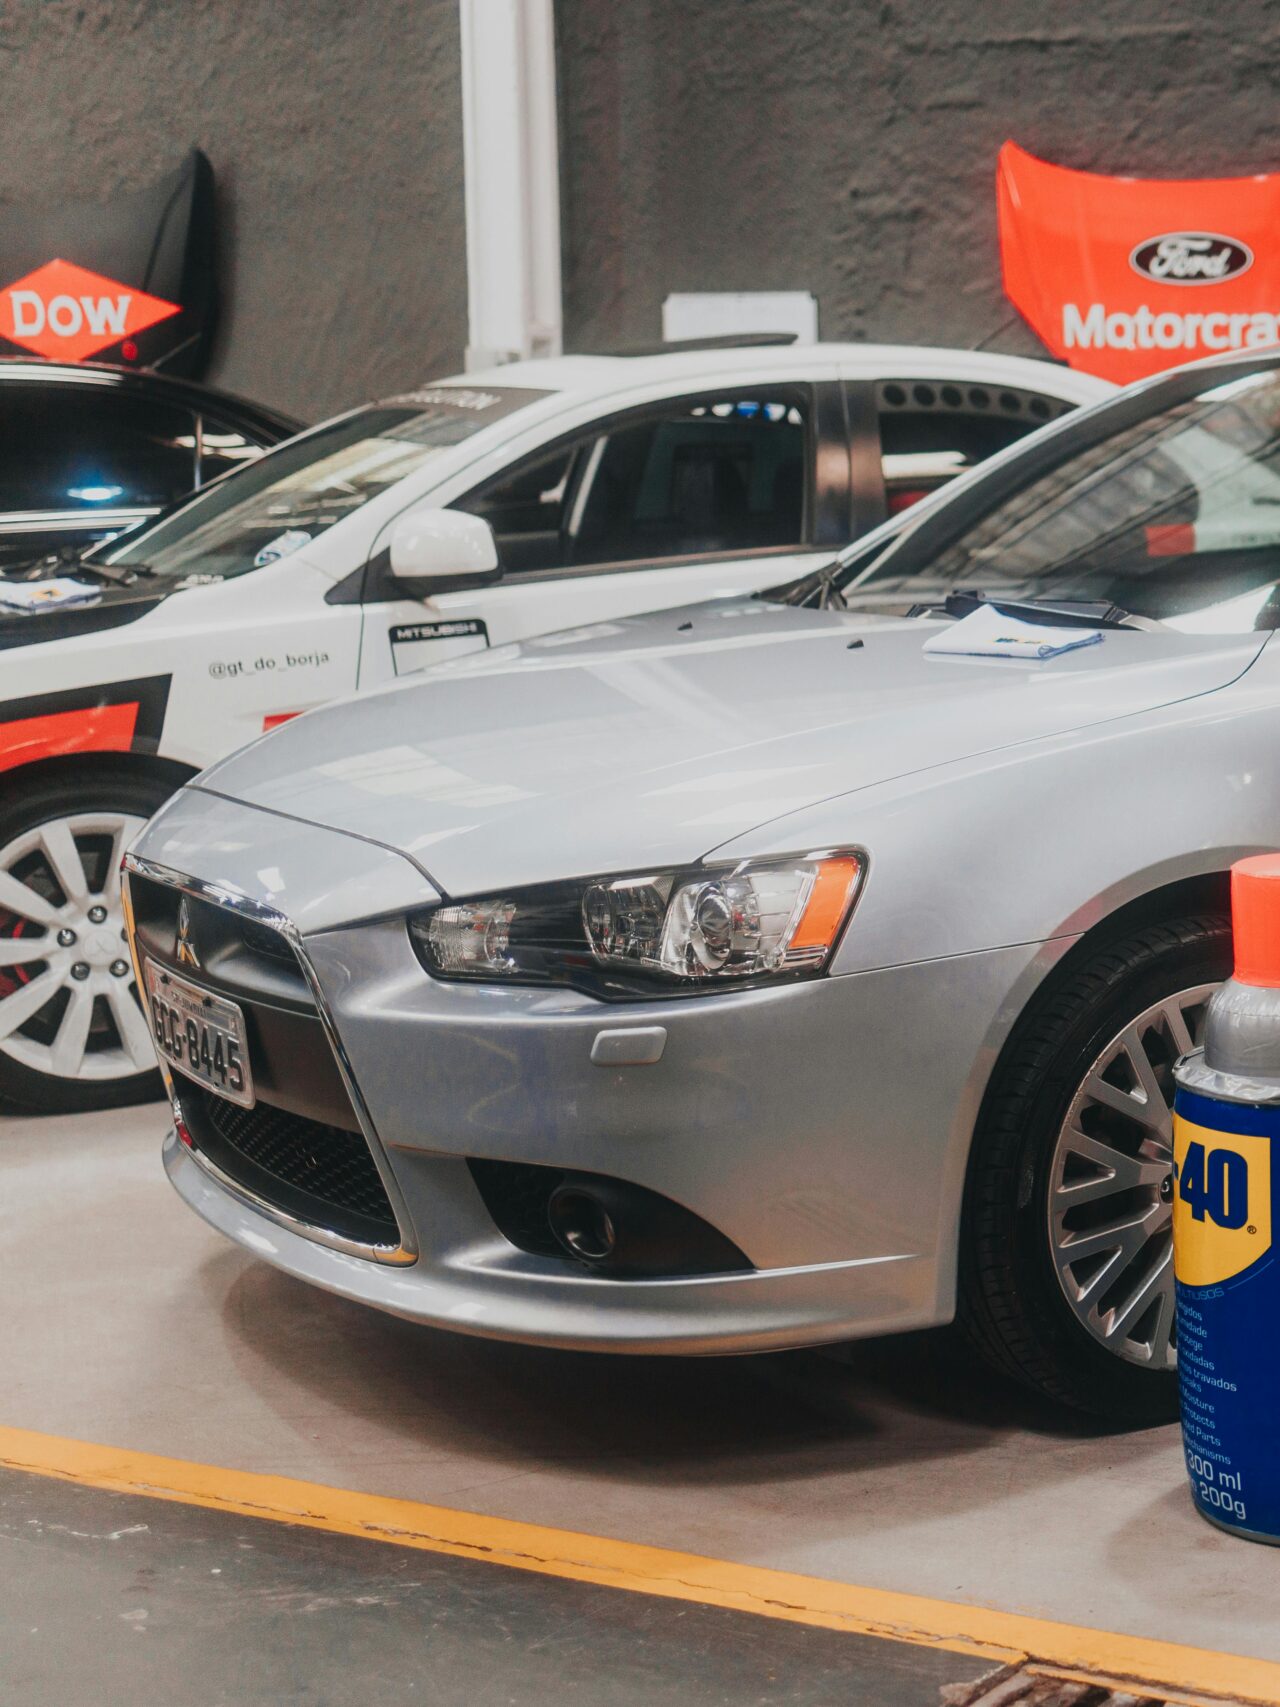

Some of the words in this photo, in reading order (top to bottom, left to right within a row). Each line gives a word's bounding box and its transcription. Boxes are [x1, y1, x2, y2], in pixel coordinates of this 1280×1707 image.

[1149, 238, 1232, 278] Ford
[208, 650, 329, 680] @gt_do_borja
[1193, 1368, 1238, 1392] travados
[1196, 1426, 1221, 1446] Parts
[1219, 1471, 1242, 1491] ml
[1199, 1481, 1246, 1520] 200g
